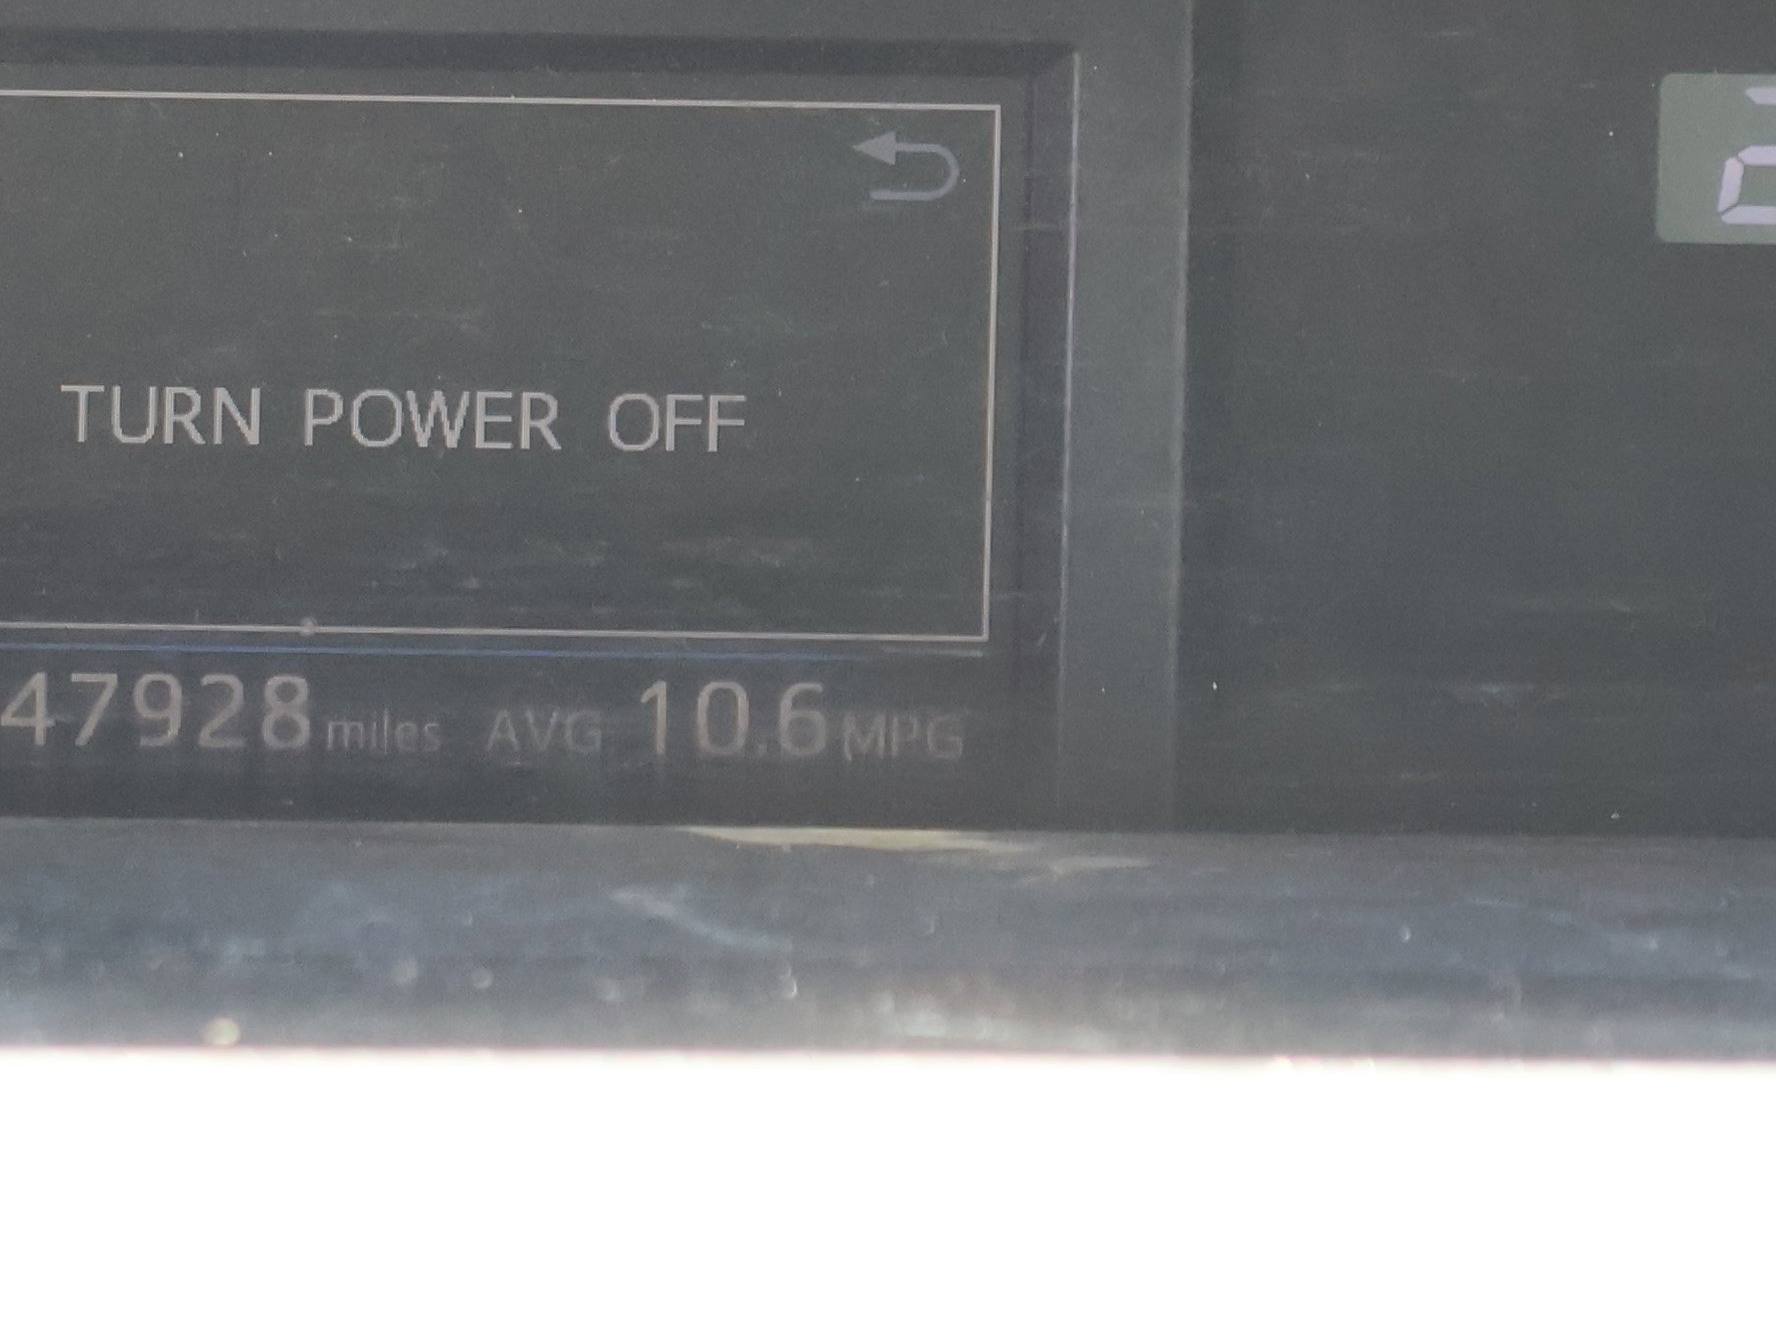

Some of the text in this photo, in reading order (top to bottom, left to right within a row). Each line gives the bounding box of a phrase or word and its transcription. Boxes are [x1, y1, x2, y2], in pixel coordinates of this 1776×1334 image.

[59, 382, 749, 454] TURN POWER OFF
[324, 703, 444, 757] miles
[484, 703, 605, 758] AVG
[639, 677, 829, 761] 10.6
[842, 708, 966, 762] MPG
